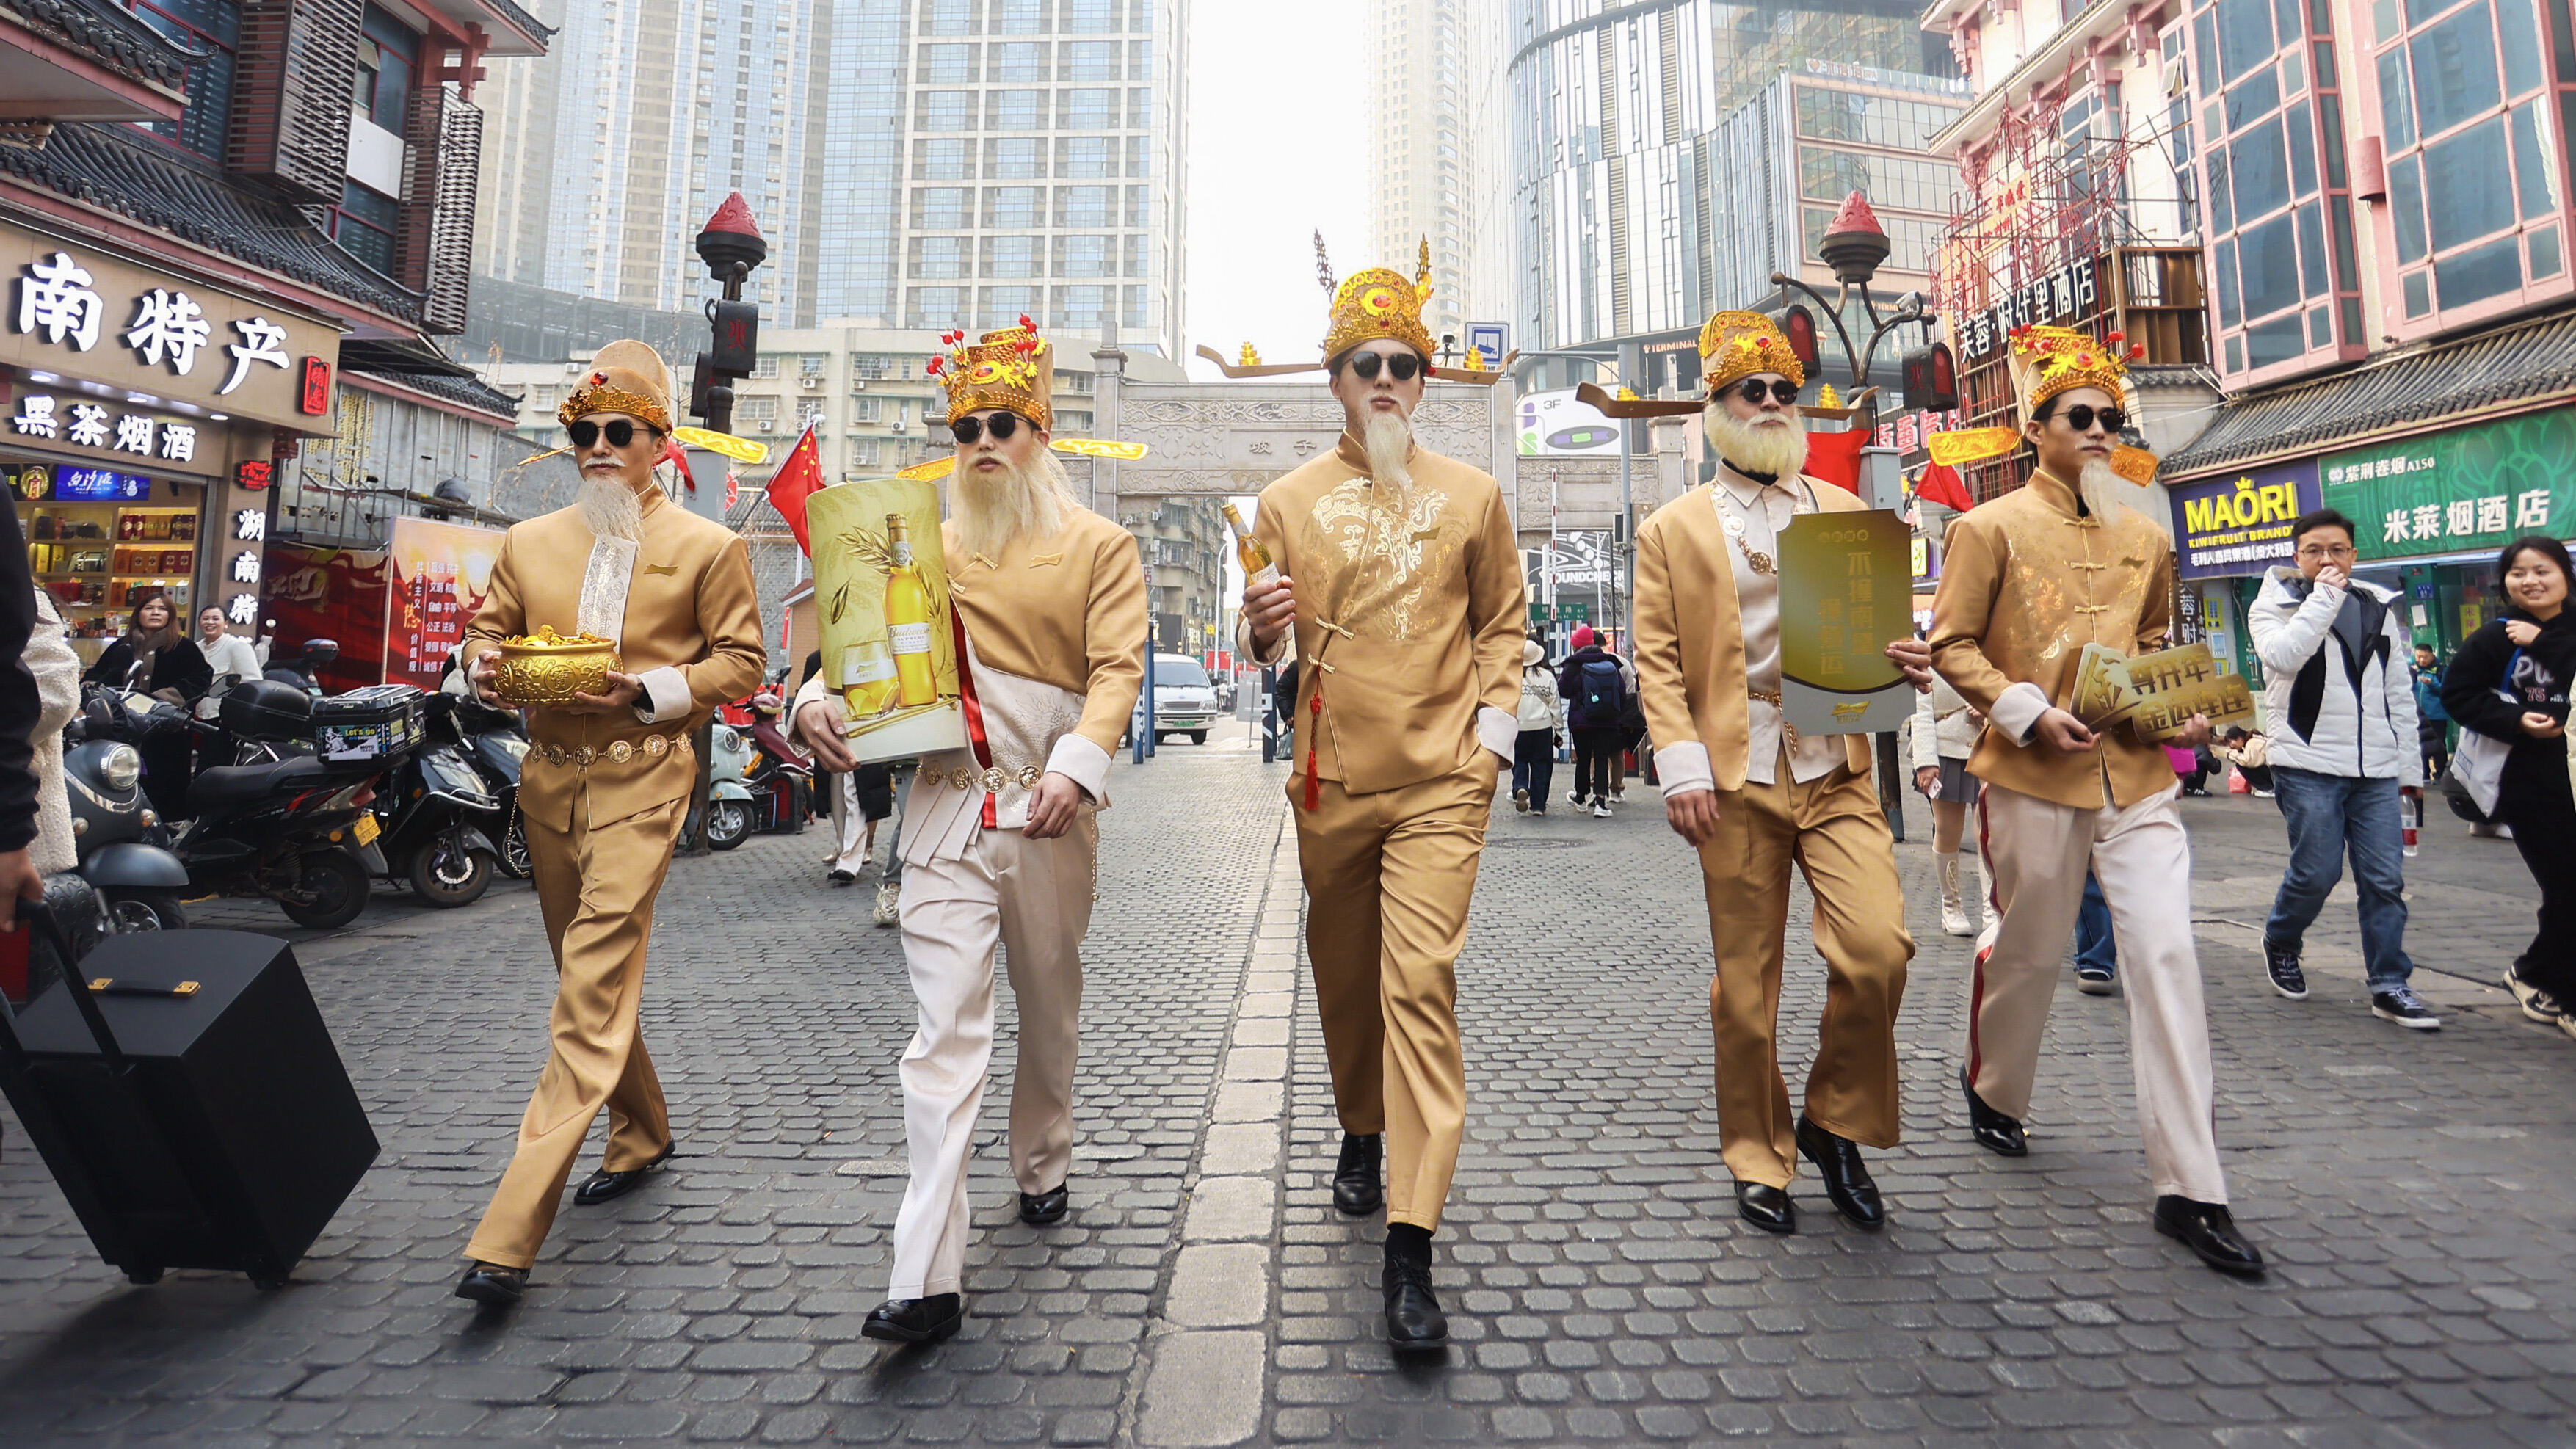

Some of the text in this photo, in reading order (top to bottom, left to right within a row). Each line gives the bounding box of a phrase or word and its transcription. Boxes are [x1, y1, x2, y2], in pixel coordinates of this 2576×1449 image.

[19, 253, 291, 395] 南特产
[1652, 339, 1697, 353] TERMINAL
[1543, 399, 1561, 410] 3F
[14, 395, 197, 462] 黑茶烟酒
[2384, 489, 2551, 543] 米莱烟酒店
[2188, 525, 2294, 548] KIWIFRUIT BRAND
[229, 508, 266, 644] 湖南特
[429, 582, 443, 593] 文明
[428, 602, 457, 614] 自由 平等
[426, 622, 455, 633] 公正 法治
